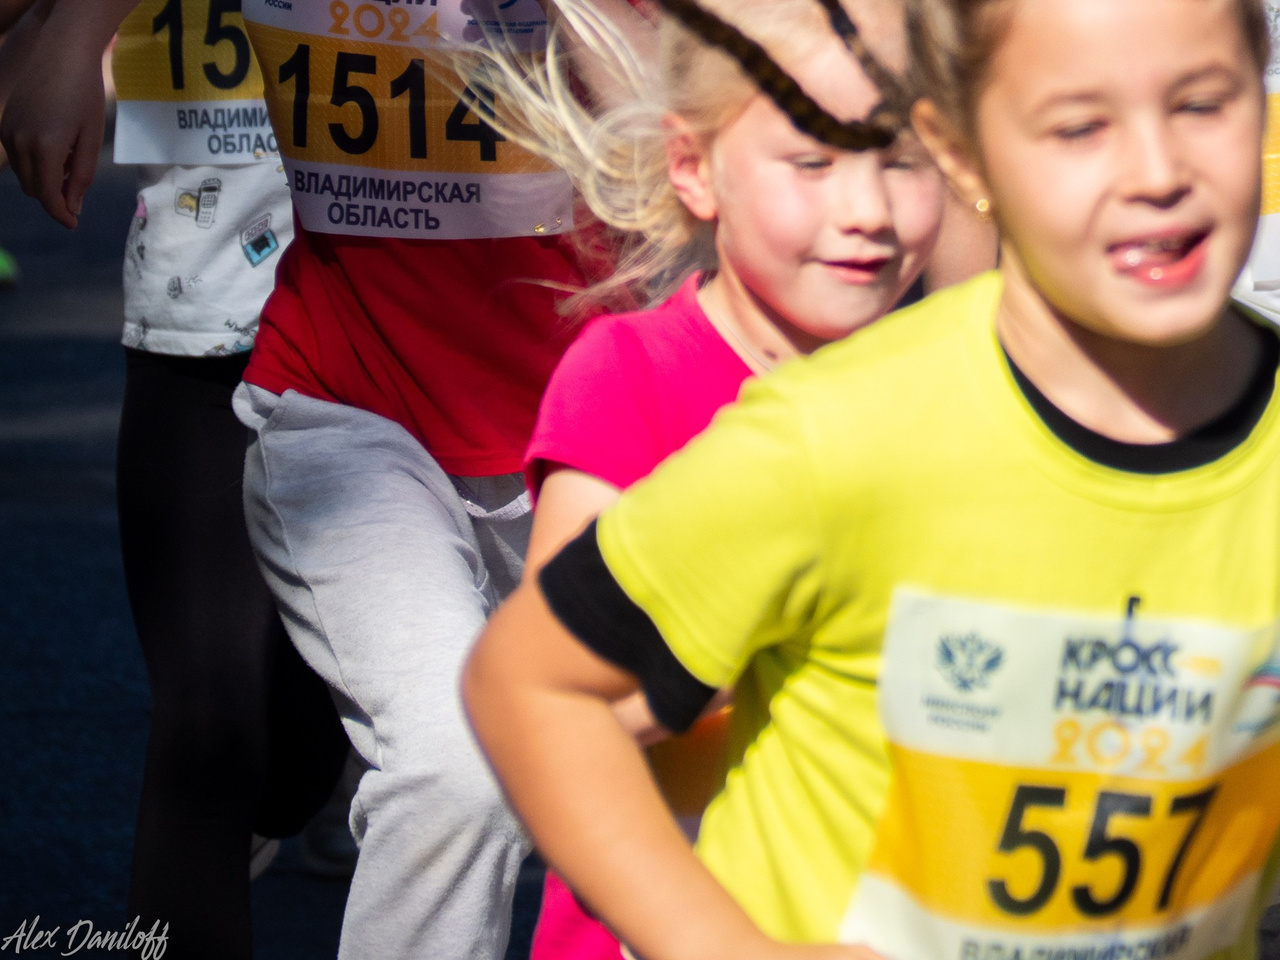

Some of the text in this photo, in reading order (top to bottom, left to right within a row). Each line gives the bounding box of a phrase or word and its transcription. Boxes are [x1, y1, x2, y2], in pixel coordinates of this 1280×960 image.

[328, 0, 441, 42] 2024
[278, 43, 507, 162] 1514
[293, 169, 481, 205] ВЛАДИМИРСКАЯ
[327, 201, 440, 231] ОБЛАСТЬ
[1060, 636, 1178, 679] КРОСС
[1053, 675, 1215, 725] НАЦИИ
[1052, 718, 1211, 774] 2024
[986, 782, 1224, 919] 557
